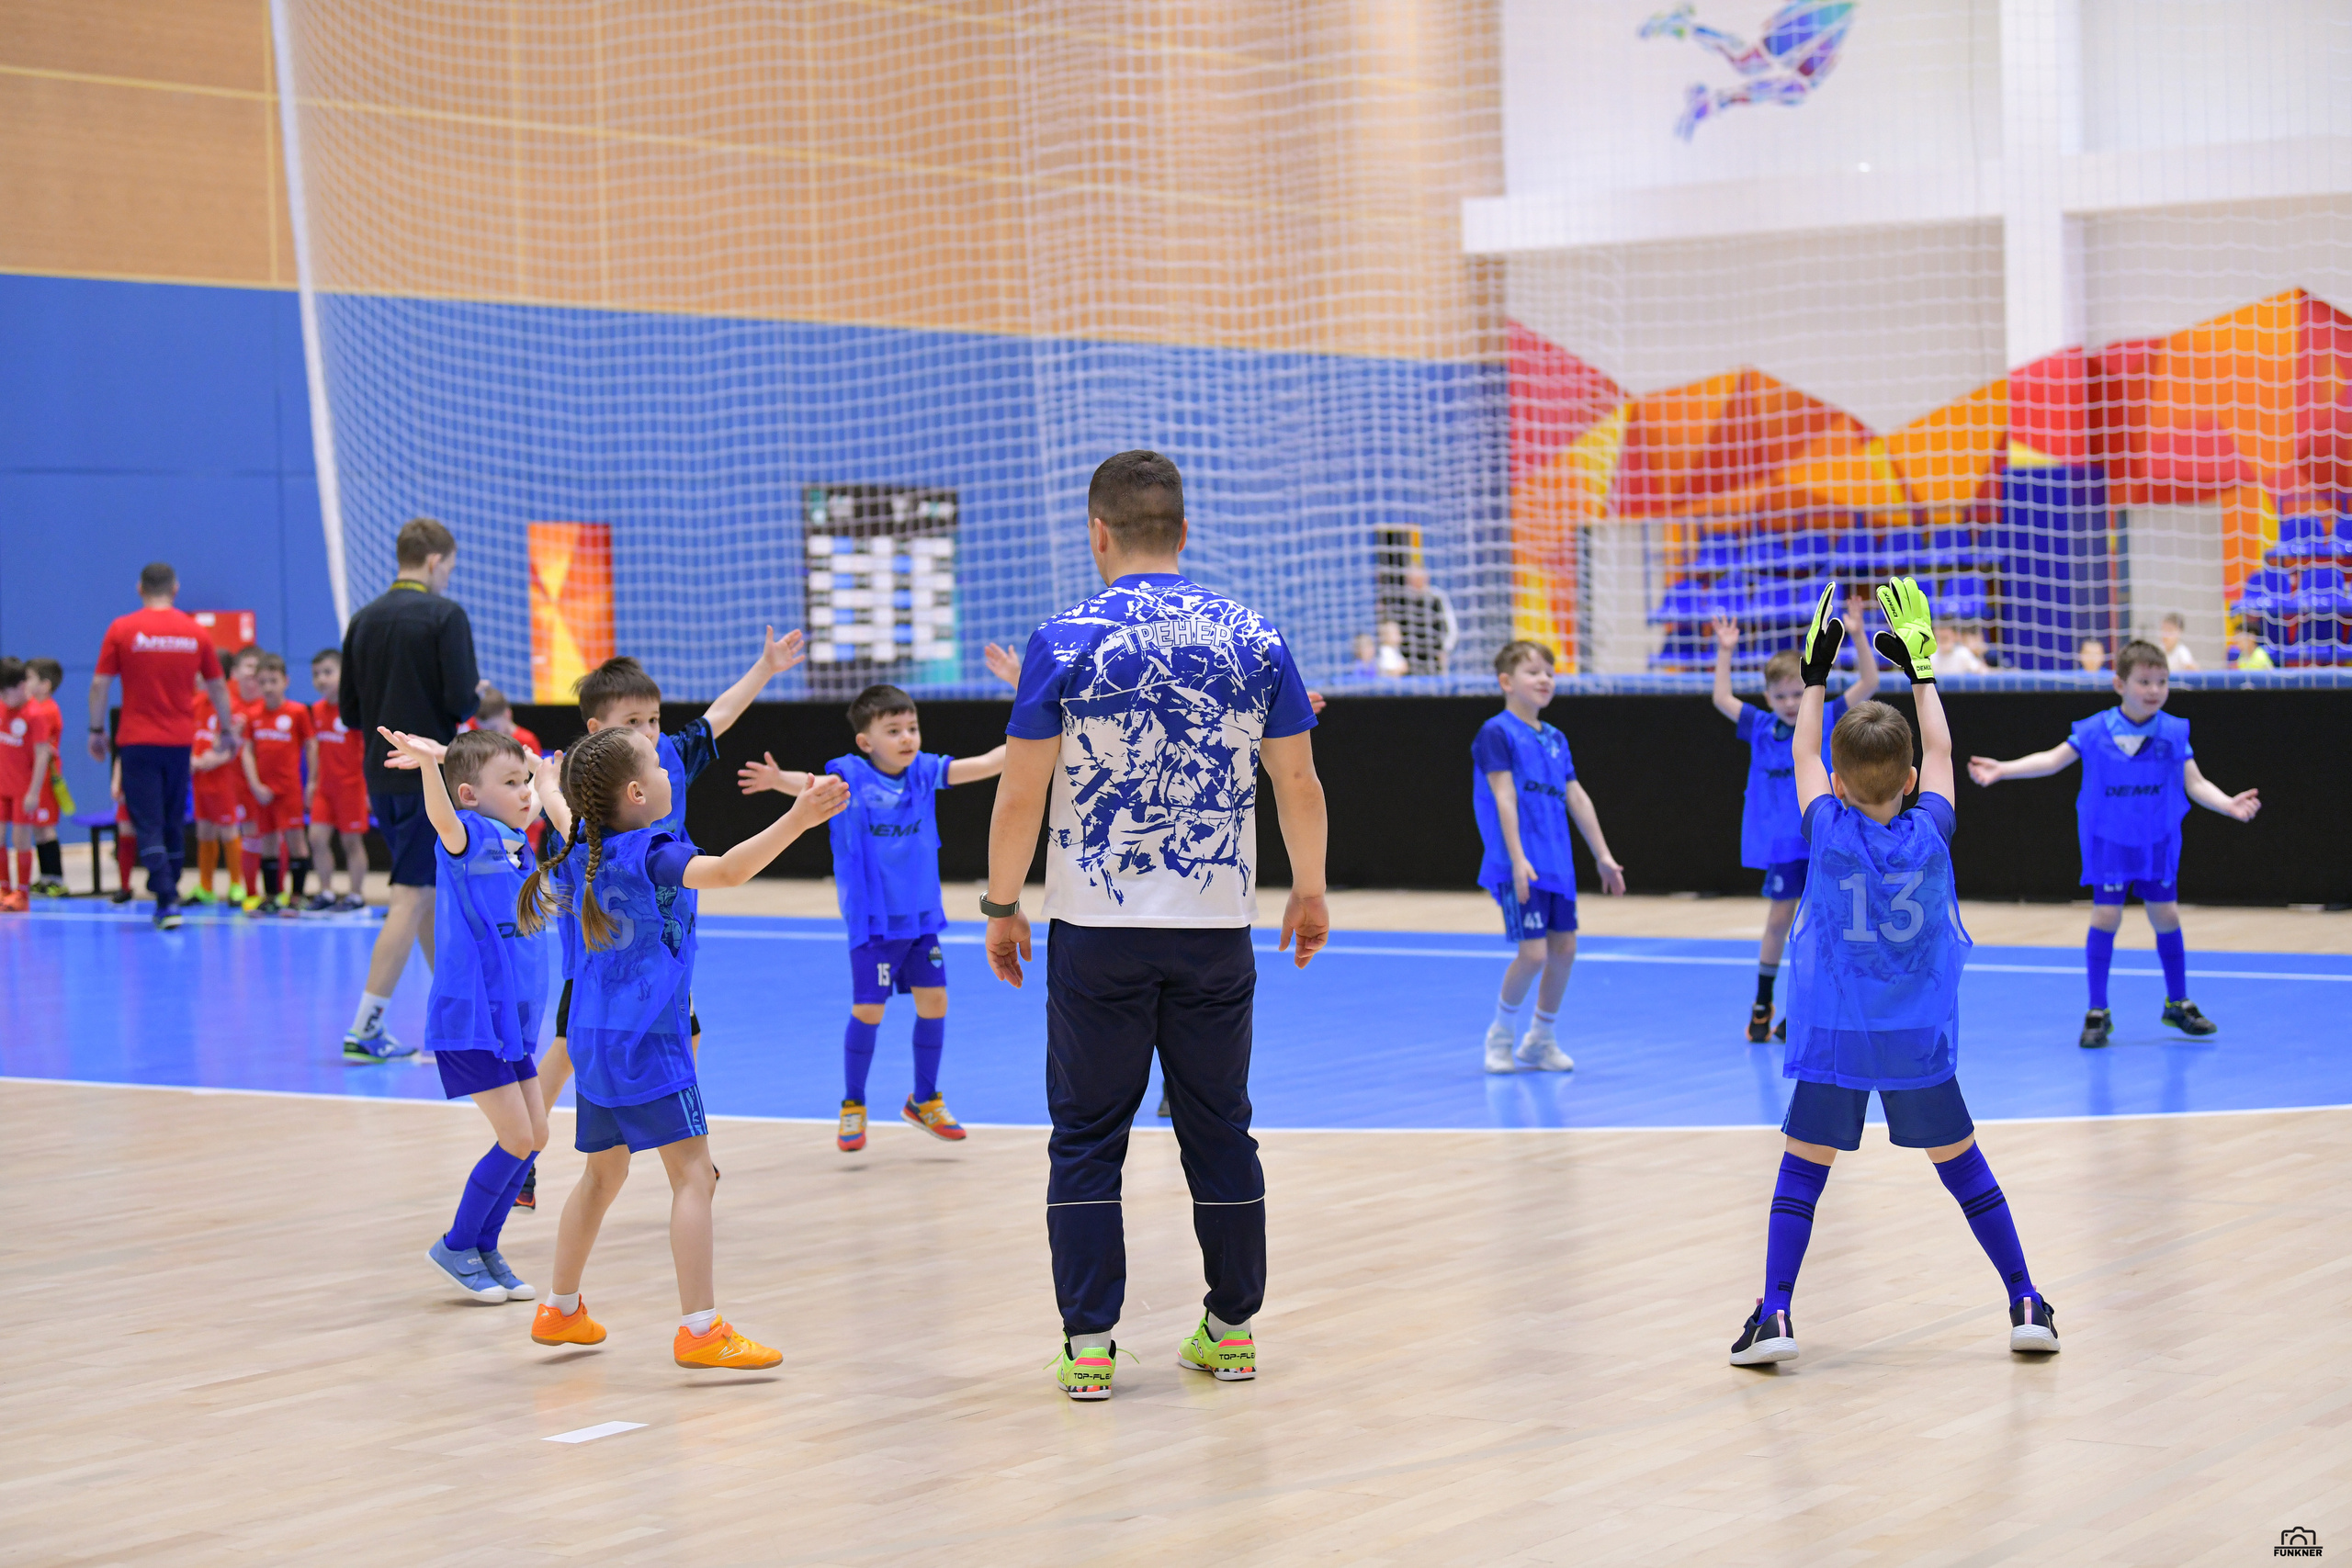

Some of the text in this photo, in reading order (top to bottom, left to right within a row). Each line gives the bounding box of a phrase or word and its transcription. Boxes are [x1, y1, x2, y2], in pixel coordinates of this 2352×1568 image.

[1883, 591, 1899, 618] DEMIX
[1114, 620, 1233, 655] ТРЕНЕР
[1838, 870, 1925, 943] 13
[876, 963, 891, 987] 15
[1218, 1352, 1256, 1360] TOP-FLE
